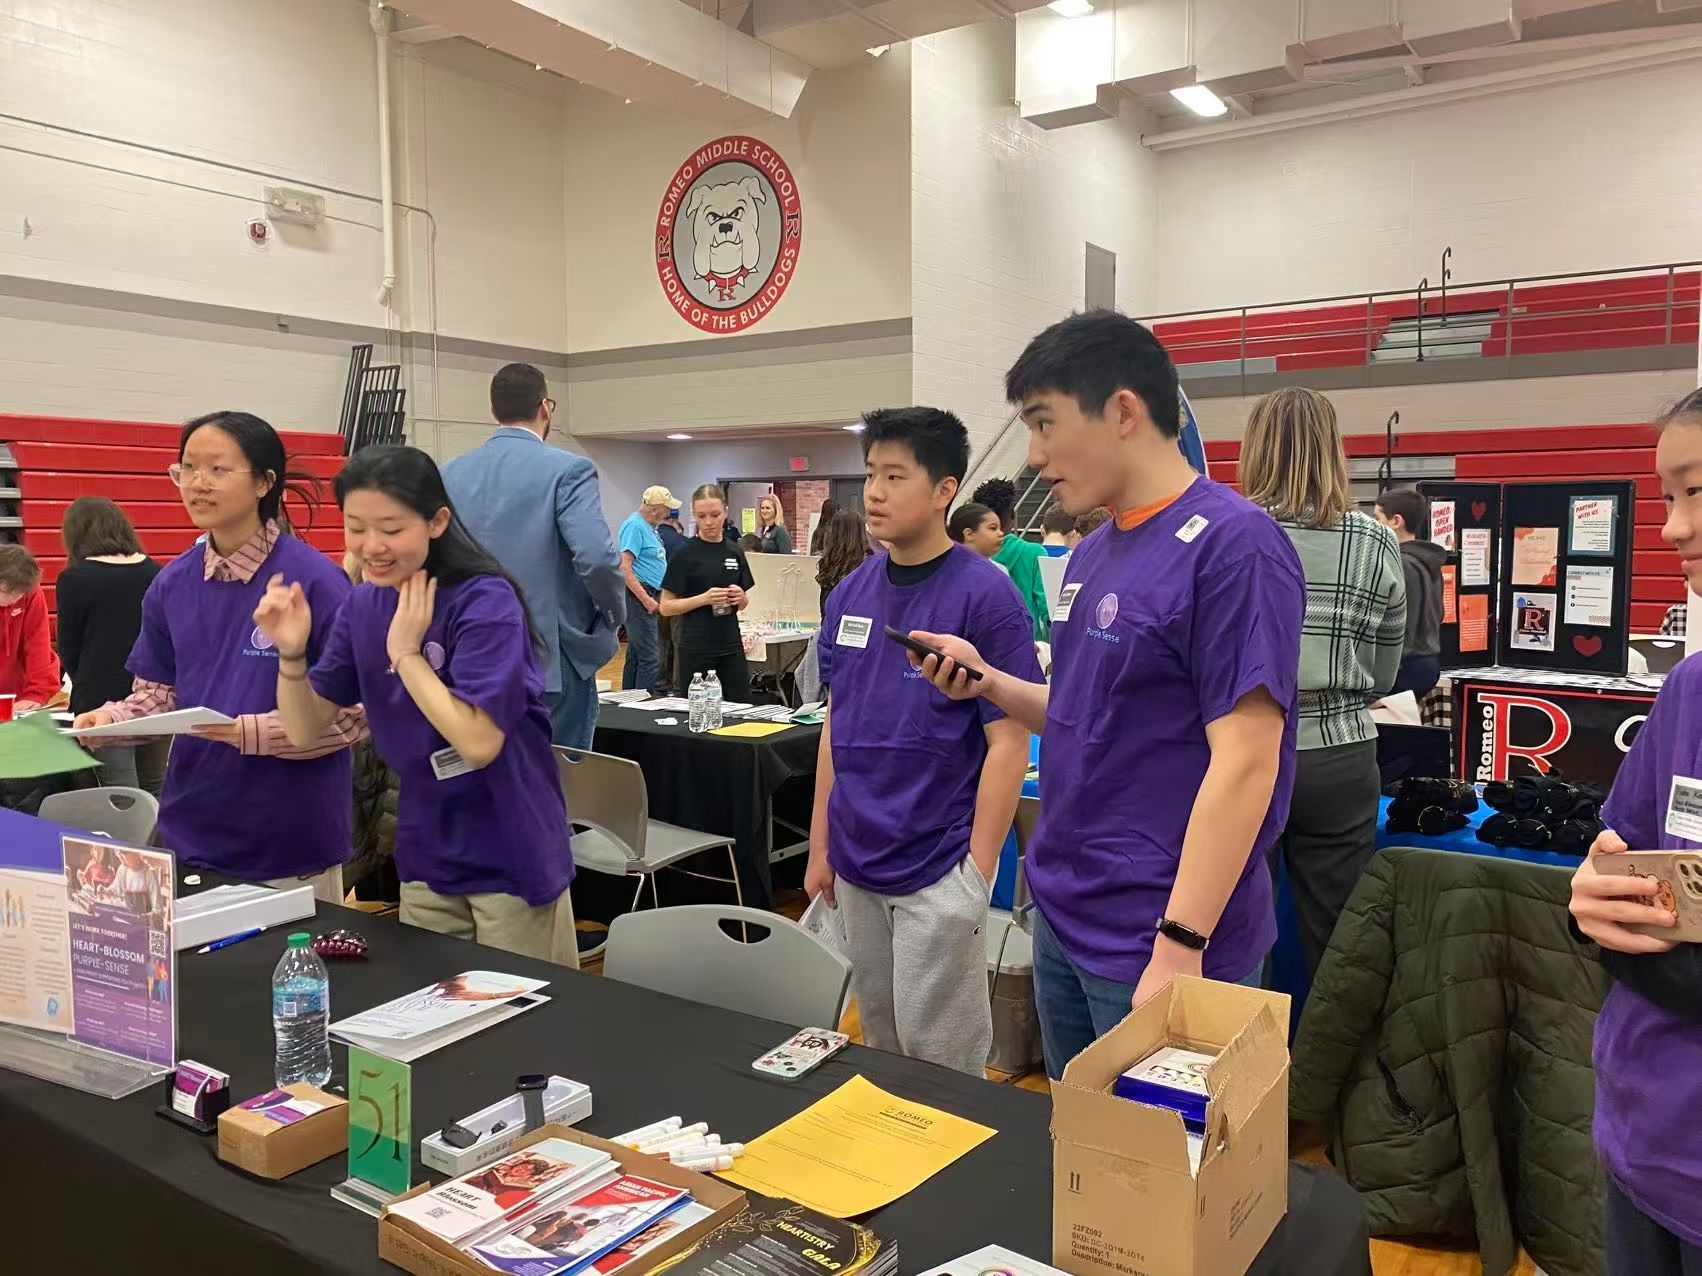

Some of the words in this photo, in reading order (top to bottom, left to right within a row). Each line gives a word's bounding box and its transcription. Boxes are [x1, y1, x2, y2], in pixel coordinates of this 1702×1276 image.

[660, 166, 694, 227] ROMEO
[696, 140, 750, 168] MIDDLE
[752, 145, 795, 207] SCHOOL
[661, 266, 689, 313] HOME
[691, 308, 709, 326] OF
[711, 314, 737, 330] THE
[740, 247, 796, 325] BULLDOGS
[1432, 507, 1450, 518] ROMEO
[1576, 502, 1598, 513] PARTNER
[1577, 510, 1590, 519] WITH
[1524, 608, 1545, 631] R
[1086, 627, 1101, 638] Purple
[1102, 631, 1120, 643] Sense
[1476, 705, 1494, 782] Romeo
[1477, 692, 1572, 781] R
[72, 939, 145, 964] HEART-BLOSSOM
[73, 954, 129, 976] PURPLE-SENSE
[356, 1068, 402, 1161] 51
[895, 1110, 934, 1125] ROMEO
[436, 1191, 478, 1210] Blossom
[445, 1187, 482, 1202] HEART
[776, 1221, 836, 1250] HEARTISTRY
[1071, 1231, 1089, 1243] SKU:
[801, 1248, 842, 1270] GALA
[1071, 1240, 1105, 1257] Quantity:
[1071, 1249, 1116, 1269] Description:
